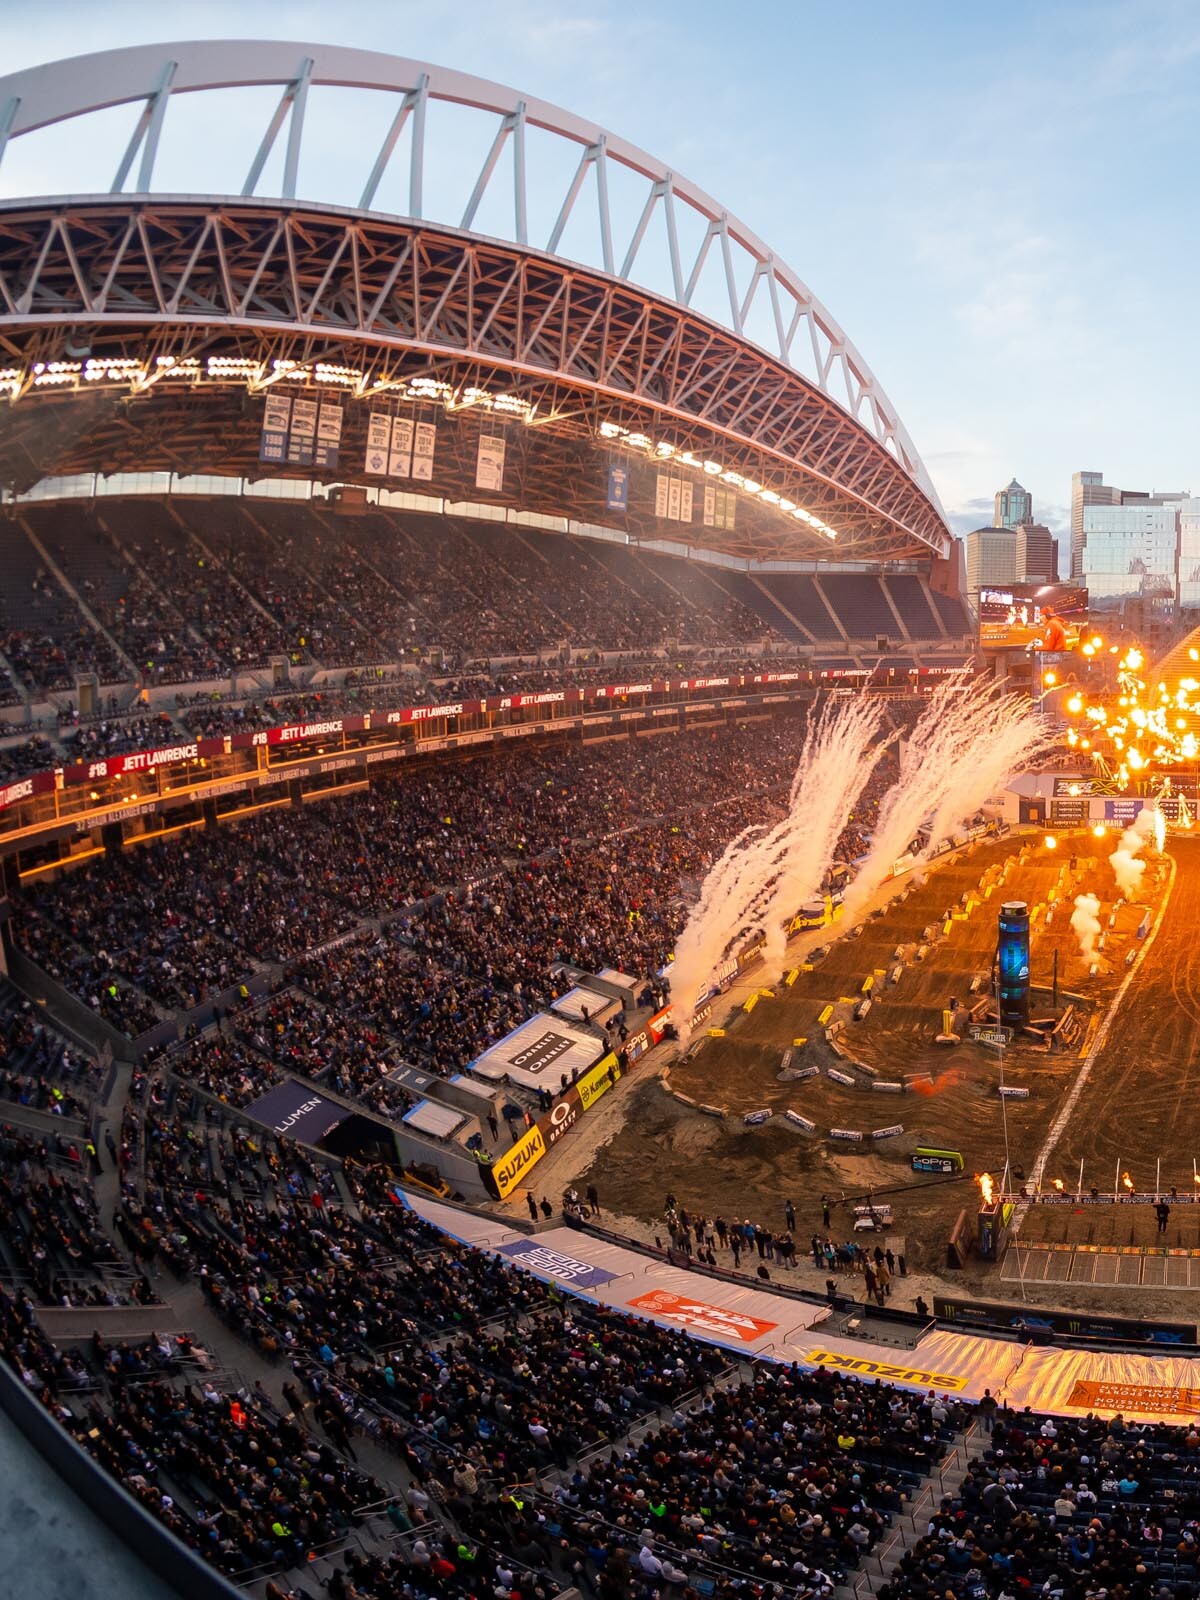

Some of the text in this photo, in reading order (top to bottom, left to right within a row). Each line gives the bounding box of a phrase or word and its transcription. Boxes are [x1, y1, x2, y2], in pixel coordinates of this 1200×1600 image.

[768, 673, 777, 681] JETT
[777, 672, 798, 681] LAWRENCE
[842, 669, 873, 677] LAWRENCE
[942, 667, 974, 675] LAWRENCE
[694, 679, 705, 687] JETT
[705, 677, 729, 687] LAWRENCE
[613, 686, 626, 695] JETT
[626, 684, 653, 694] LAWRENCE
[520, 695, 534, 705] JETT
[534, 692, 565, 703] LAWRENCE
[387, 704, 463, 723] #18 JETT LAWRENCE
[252, 720, 343, 745] #18 JETT LAWRENCE
[88, 744, 198, 778] #18 JETT LAWRENCE
[1096, 819, 1124, 828] YAMAHA
[275, 1097, 323, 1133] LUMEN
[549, 1109, 577, 1142] OAKLEY
[497, 1134, 543, 1189] SUZUKI
[912, 1156, 952, 1166] GoPro
[812, 1352, 961, 1389] SUZUKI
[1098, 1388, 1142, 1398] SPORTS
[1093, 1401, 1139, 1411] SPORTS
[1094, 1397, 1178, 1409] COMMISSION
